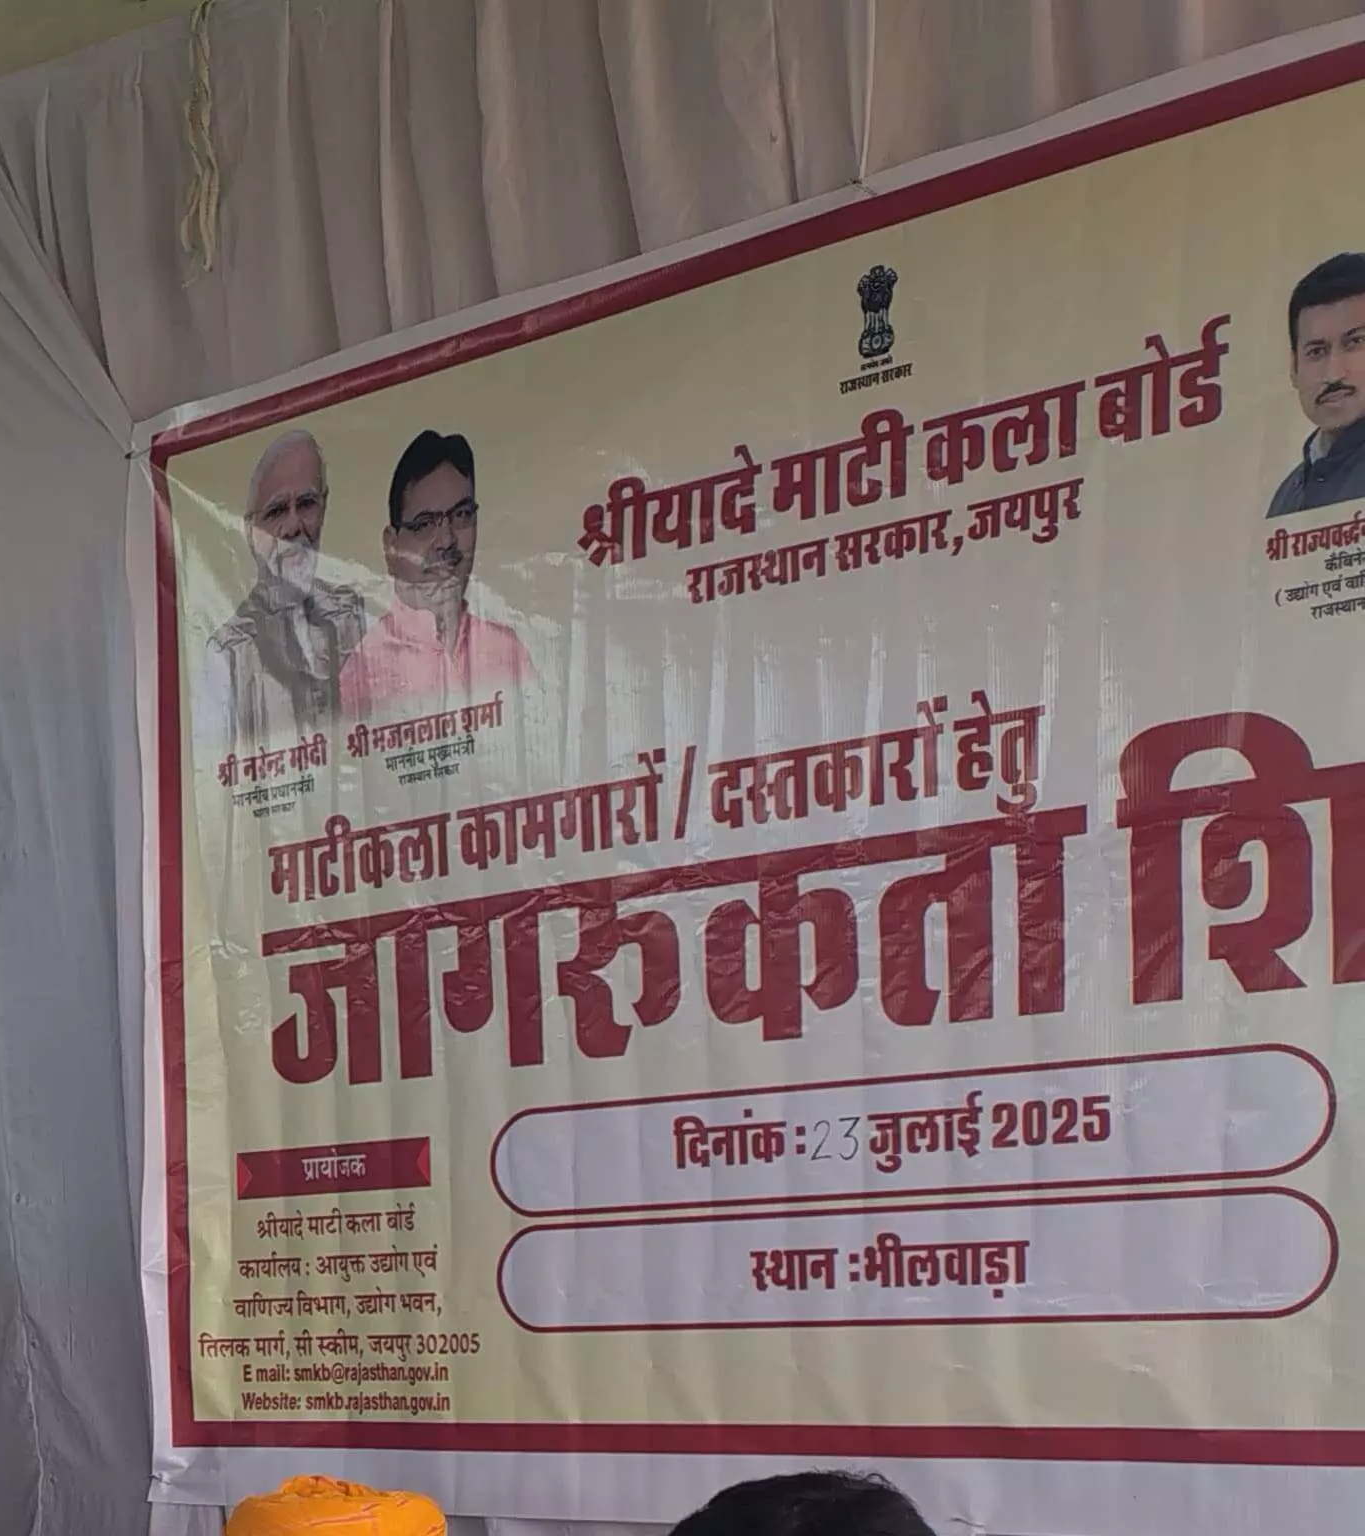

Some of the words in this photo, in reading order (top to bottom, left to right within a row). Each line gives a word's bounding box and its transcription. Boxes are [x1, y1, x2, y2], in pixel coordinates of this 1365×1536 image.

[881, 362, 914, 384] सरकार
[577, 444, 763, 568] श्रीयादे
[771, 408, 914, 521] माटी
[923, 380, 1086, 486] कला
[1094, 314, 1231, 444] बोर्ड
[1266, 528, 1289, 561] श्री
[686, 537, 829, 604] राजस्थान
[347, 724, 369, 759] श्री
[372, 710, 458, 753] भजनलाल
[460, 690, 504, 733] शर्मा
[217, 753, 239, 788] श्री
[289, 732, 327, 772] मोदी
[269, 815, 450, 903] माटीकला
[456, 747, 667, 870] कामगारों
[708, 692, 946, 829] दस्तकारों
[953, 688, 1046, 815] हेतु
[810, 1116, 860, 1162] 23
[868, 1090, 983, 1172] जुलाई
[991, 1095, 1111, 1148] 2025
[302, 1149, 367, 1181] प्रायोजक
[257, 1209, 304, 1240] श्रीयादे
[307, 1206, 343, 1236] माटी
[345, 1211, 381, 1234] कला
[386, 1202, 416, 1232] बोर्ड
[316, 1255, 365, 1282] आयुक्त
[369, 1246, 409, 1274] उद्योग
[411, 1243, 438, 1277] एवं
[233, 1292, 294, 1319] वाणिज्य
[296, 1292, 352, 1319] विभाग,
[355, 1286, 397, 1314] उद्योग
[400, 1290, 442, 1316] भवन,
[198, 1332, 250, 1360] तिलक
[254, 1330, 290, 1358] मार्ग,
[295, 1329, 313, 1357] सी
[317, 1328, 364, 1357] स्कीम,
[367, 1333, 413, 1362] जयपुर
[416, 1332, 481, 1355] 302005
[293, 1362, 450, 1386] smkb@rajasthan.gov.in
[241, 1391, 302, 1411] Website:
[305, 1391, 451, 1415] smkb.rajasthan.gov.in
